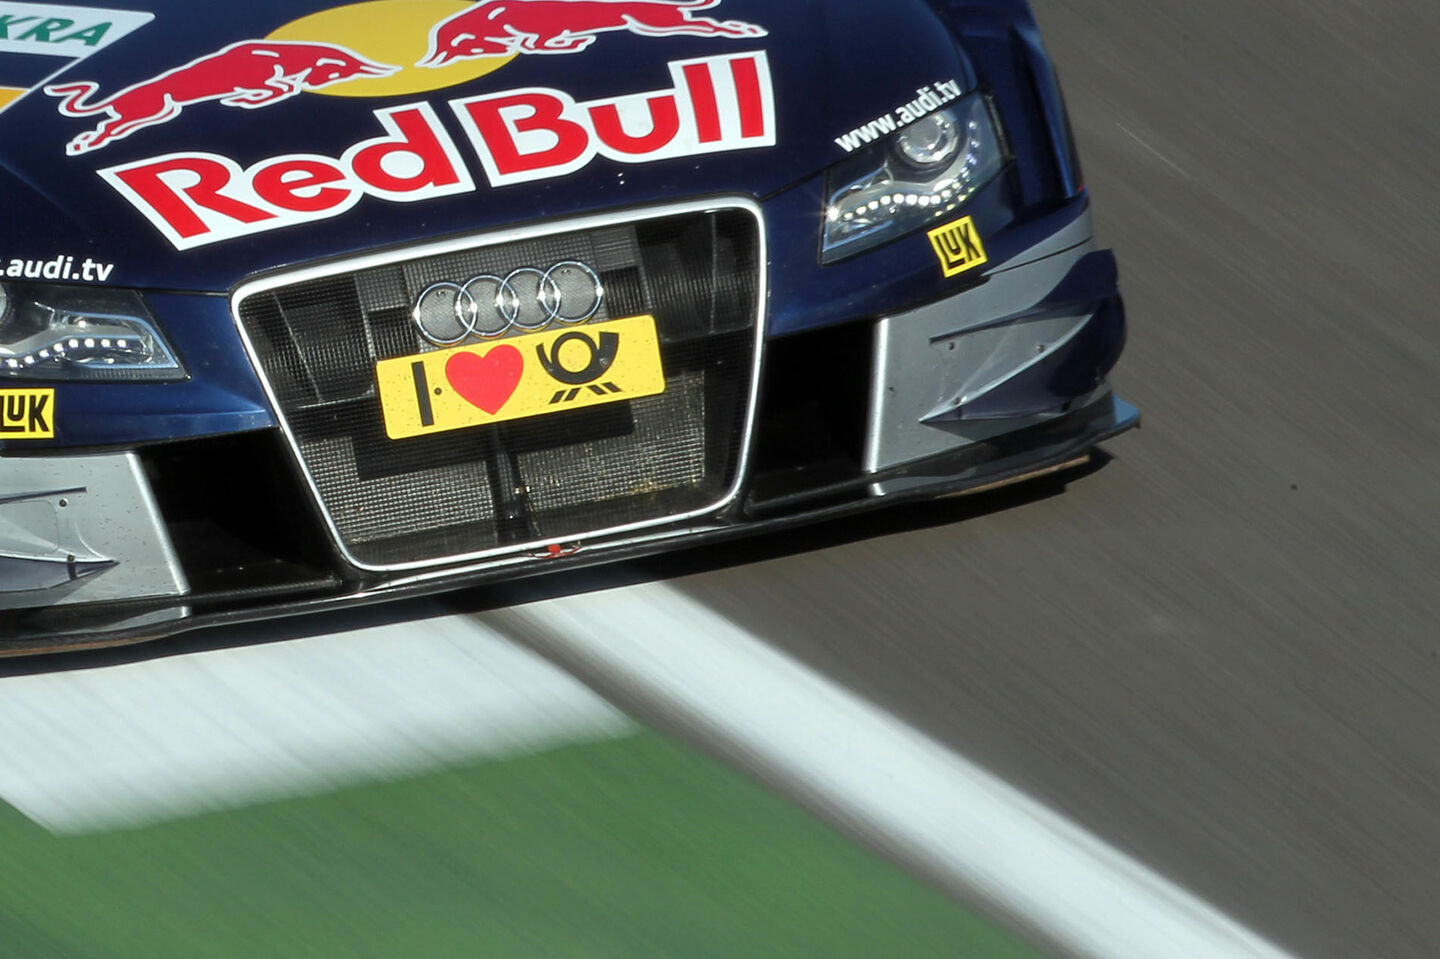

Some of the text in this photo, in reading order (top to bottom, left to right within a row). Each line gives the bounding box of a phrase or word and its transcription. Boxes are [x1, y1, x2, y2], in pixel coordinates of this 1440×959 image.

[114, 55, 769, 241] Red Bull
[834, 78, 962, 153] www.audi.tv
[934, 222, 982, 269] LUK
